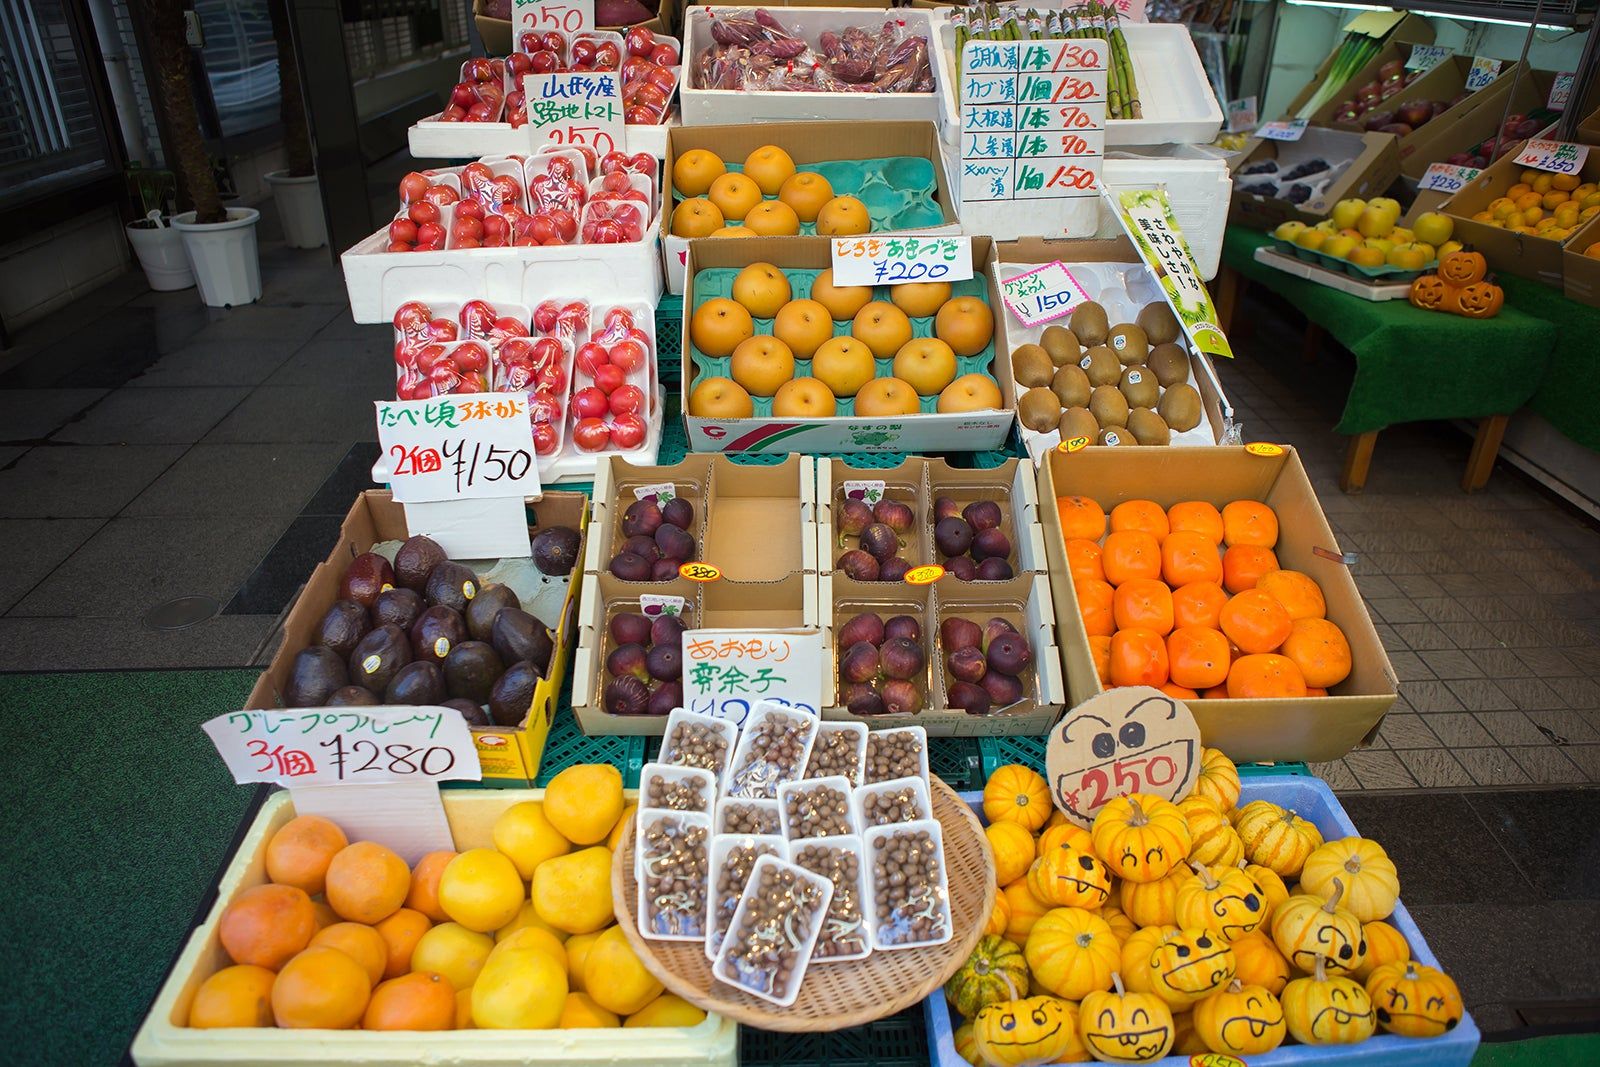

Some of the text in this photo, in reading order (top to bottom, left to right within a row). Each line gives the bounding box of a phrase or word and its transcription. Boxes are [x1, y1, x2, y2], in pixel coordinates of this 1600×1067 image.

[523, 6, 583, 33] 250
[543, 75, 616, 99] 山形産
[1153, 218, 1199, 290] さわやかな
[873, 259, 949, 283] ¥200
[390, 439, 532, 493] 2個 ¥150
[687, 638, 790, 662] あおもり
[247, 739, 317, 777] 3個
[320, 734, 455, 780] ¥280
